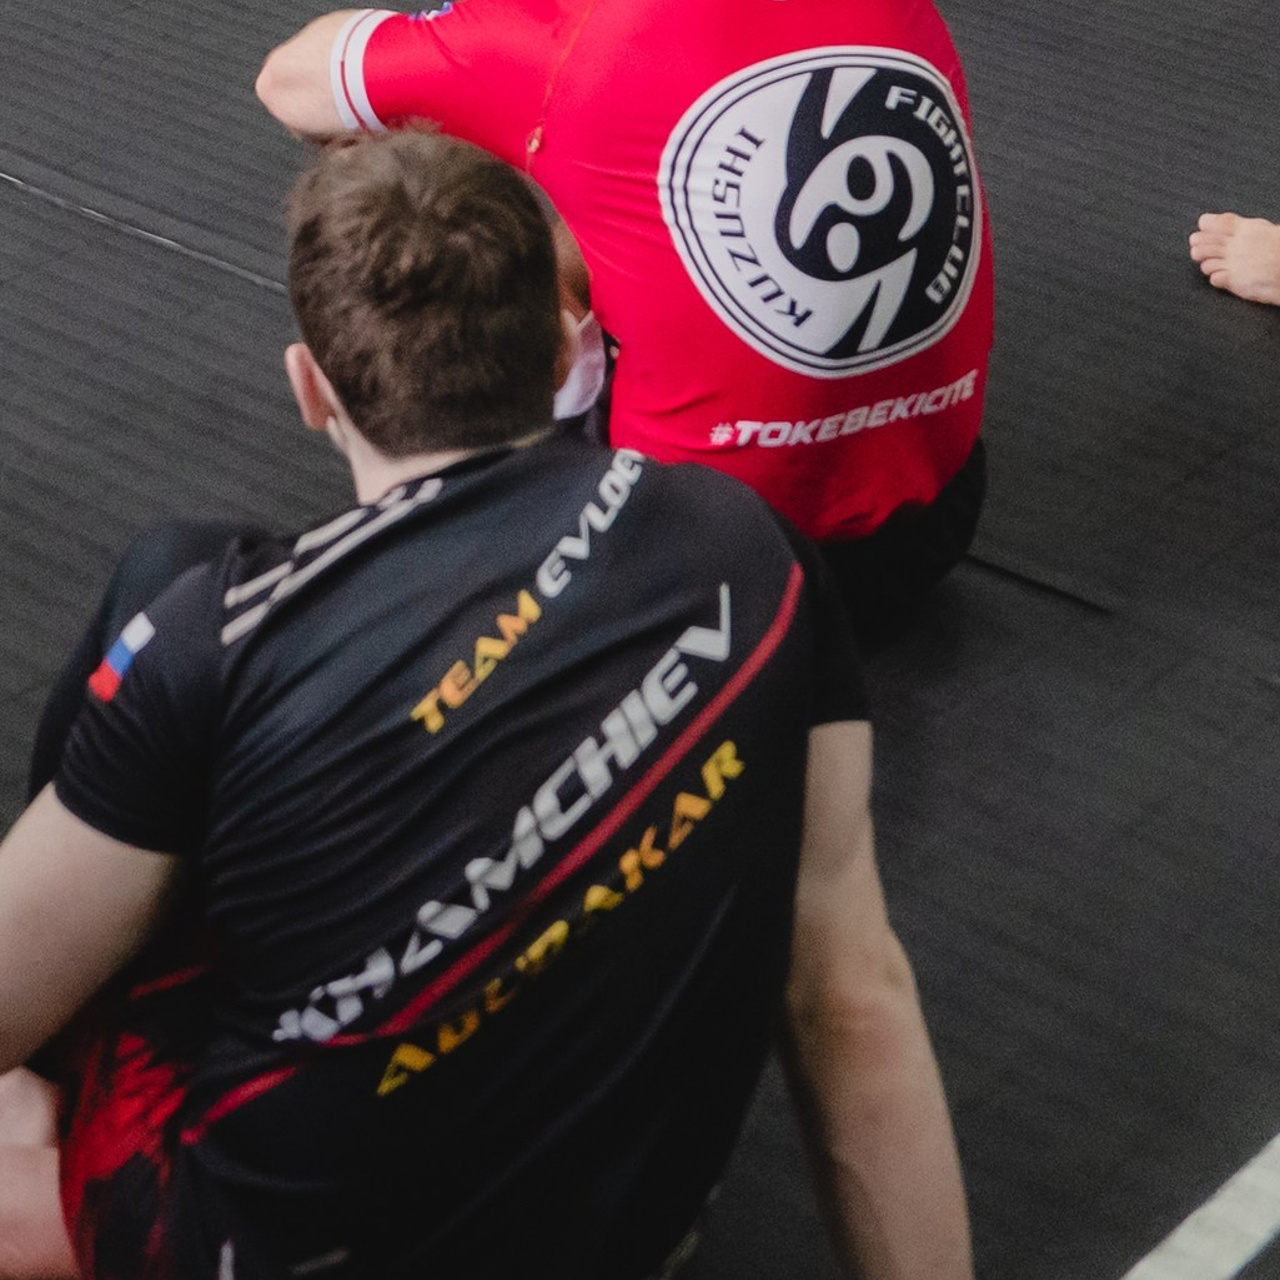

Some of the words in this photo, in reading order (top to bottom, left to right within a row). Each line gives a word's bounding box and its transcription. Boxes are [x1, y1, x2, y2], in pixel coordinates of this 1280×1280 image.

[884, 85, 967, 178] FIGHT
[711, 125, 814, 329] KUZUSHI
[924, 183, 971, 305] CLUB
[409, 588, 542, 734] TEAM
[272, 582, 733, 1043] KHAMCHIEV
